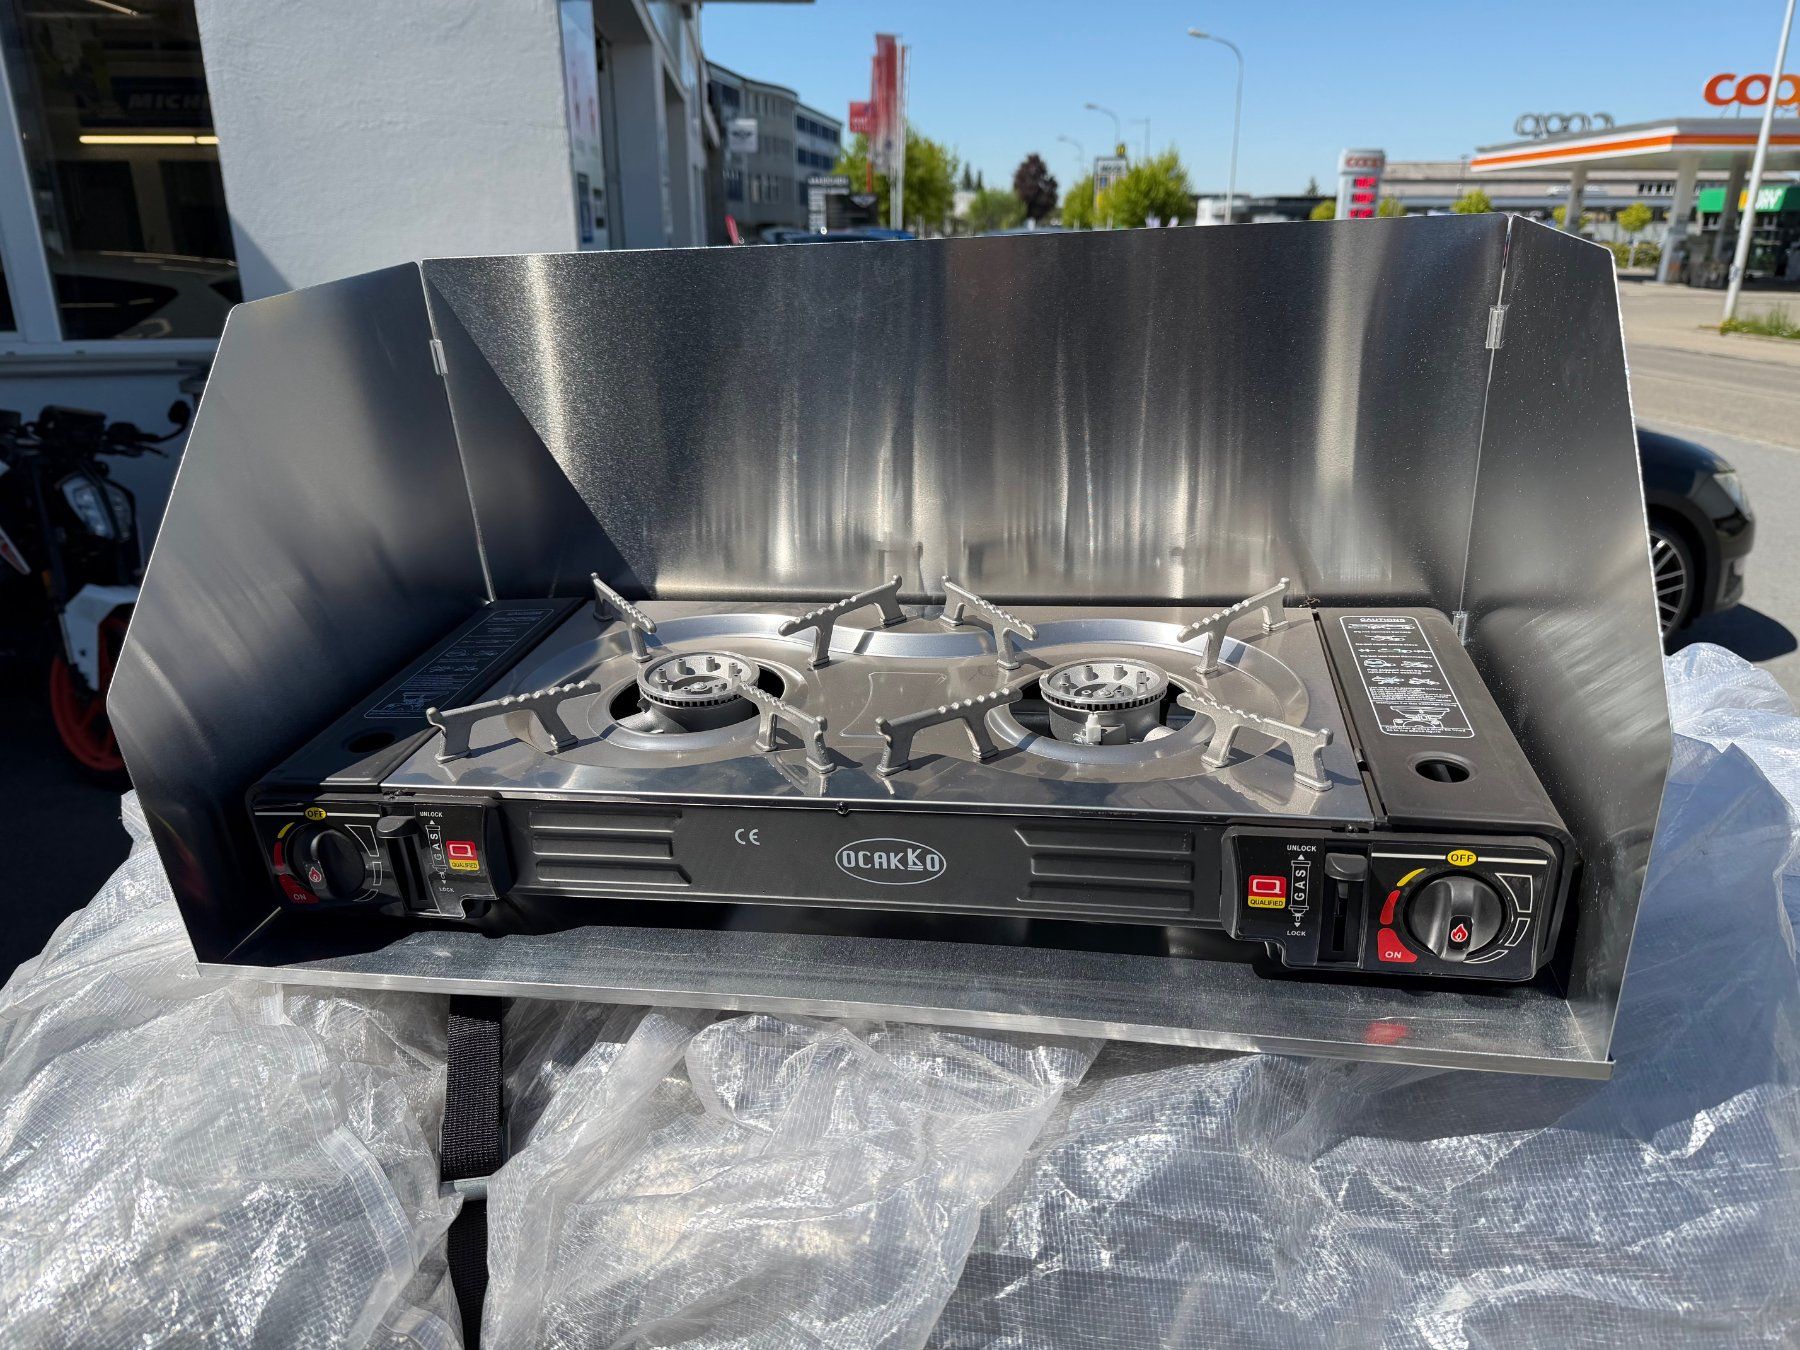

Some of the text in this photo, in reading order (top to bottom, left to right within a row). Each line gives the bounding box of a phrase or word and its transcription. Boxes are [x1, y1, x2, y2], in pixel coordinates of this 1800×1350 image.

[1704, 73, 1800, 107] coo
[307, 809, 324, 818] OFF
[734, 828, 760, 845] CE
[430, 833, 442, 861] GAS
[1286, 844, 1317, 852] UNLOCK
[842, 848, 940, 871] OCAKKO
[1450, 853, 1473, 863] OFF
[1294, 869, 1306, 901] GAS
[293, 893, 307, 901] ON
[1250, 899, 1283, 907] QUALIFIED
[1385, 950, 1402, 960] ON
